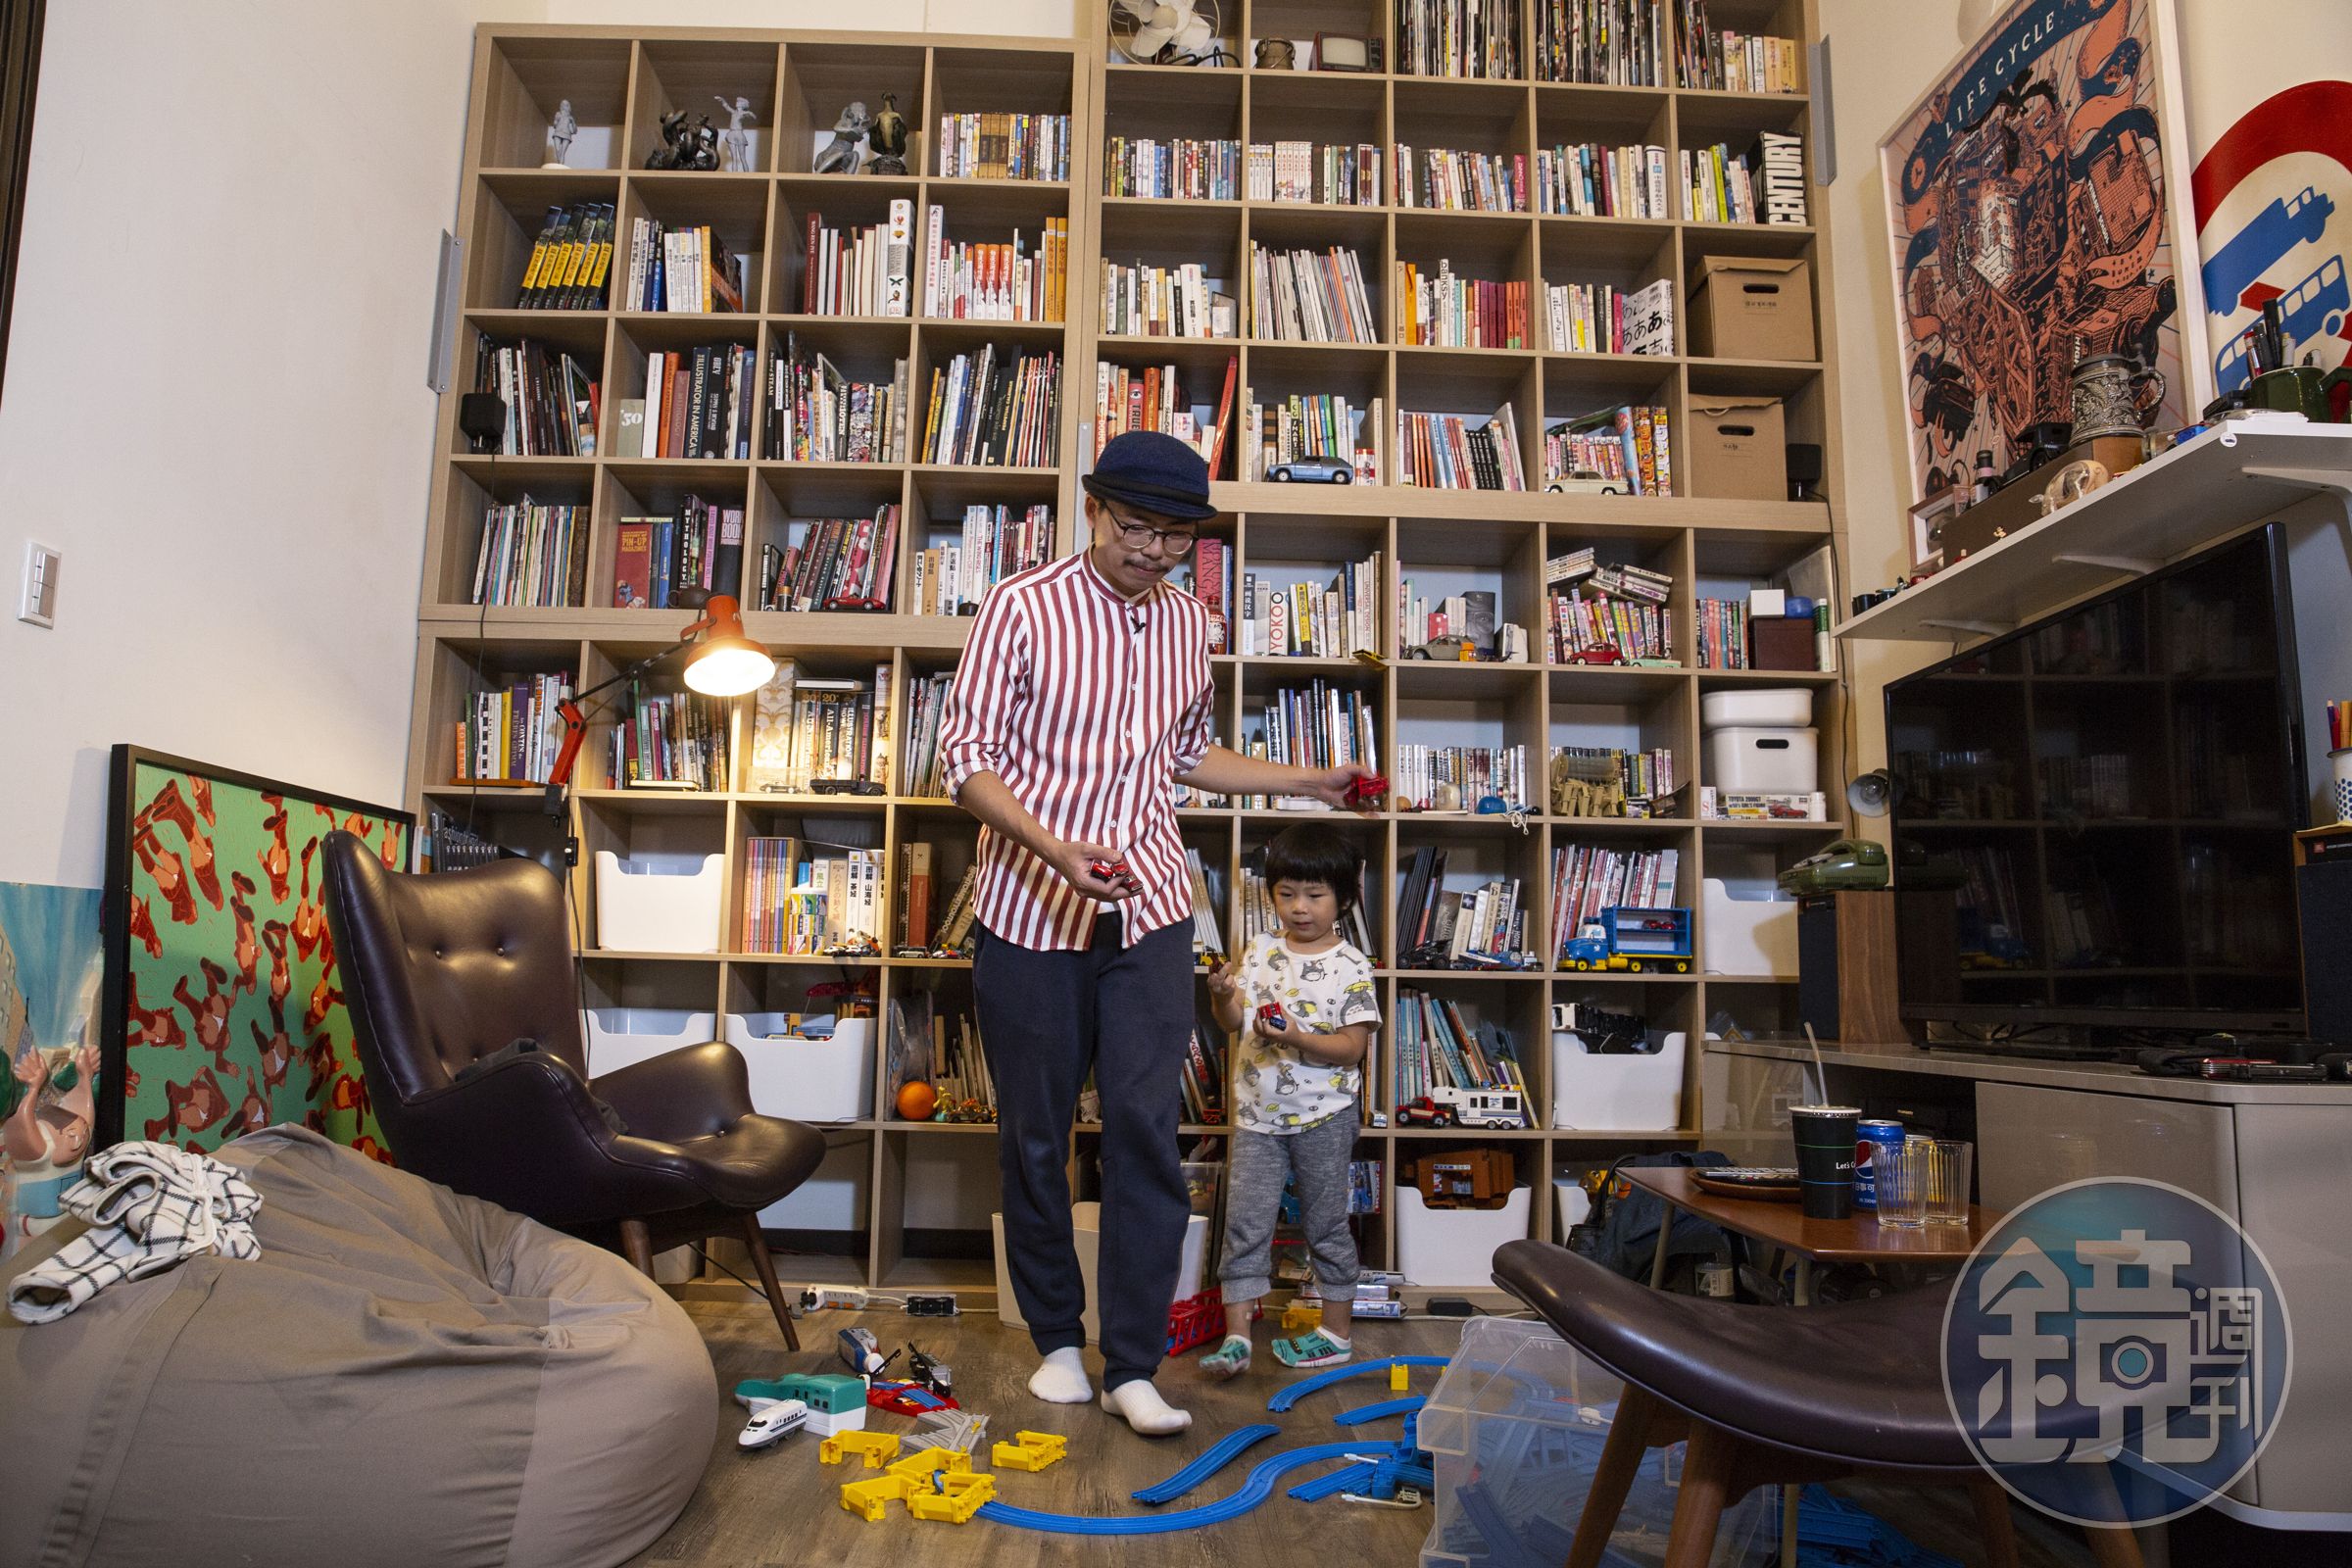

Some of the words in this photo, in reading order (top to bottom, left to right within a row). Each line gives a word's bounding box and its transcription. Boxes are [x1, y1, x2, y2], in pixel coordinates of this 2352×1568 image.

[1945, 76, 1987, 139] LIFE
[1994, 11, 2056, 76] CYCLE
[1764, 133, 1806, 226] CENTURY
[693, 358, 705, 404] ILLUSTRATOR
[712, 358, 722, 375] OBEY
[689, 415, 700, 448] AMERICA
[1132, 405, 1142, 430] TRUE
[681, 509, 692, 582] MYTHOLOGY
[1202, 542, 1213, 600] MANGA
[845, 707, 855, 758] ILLUSTRATION
[1836, 1161, 1850, 1170] Let's
